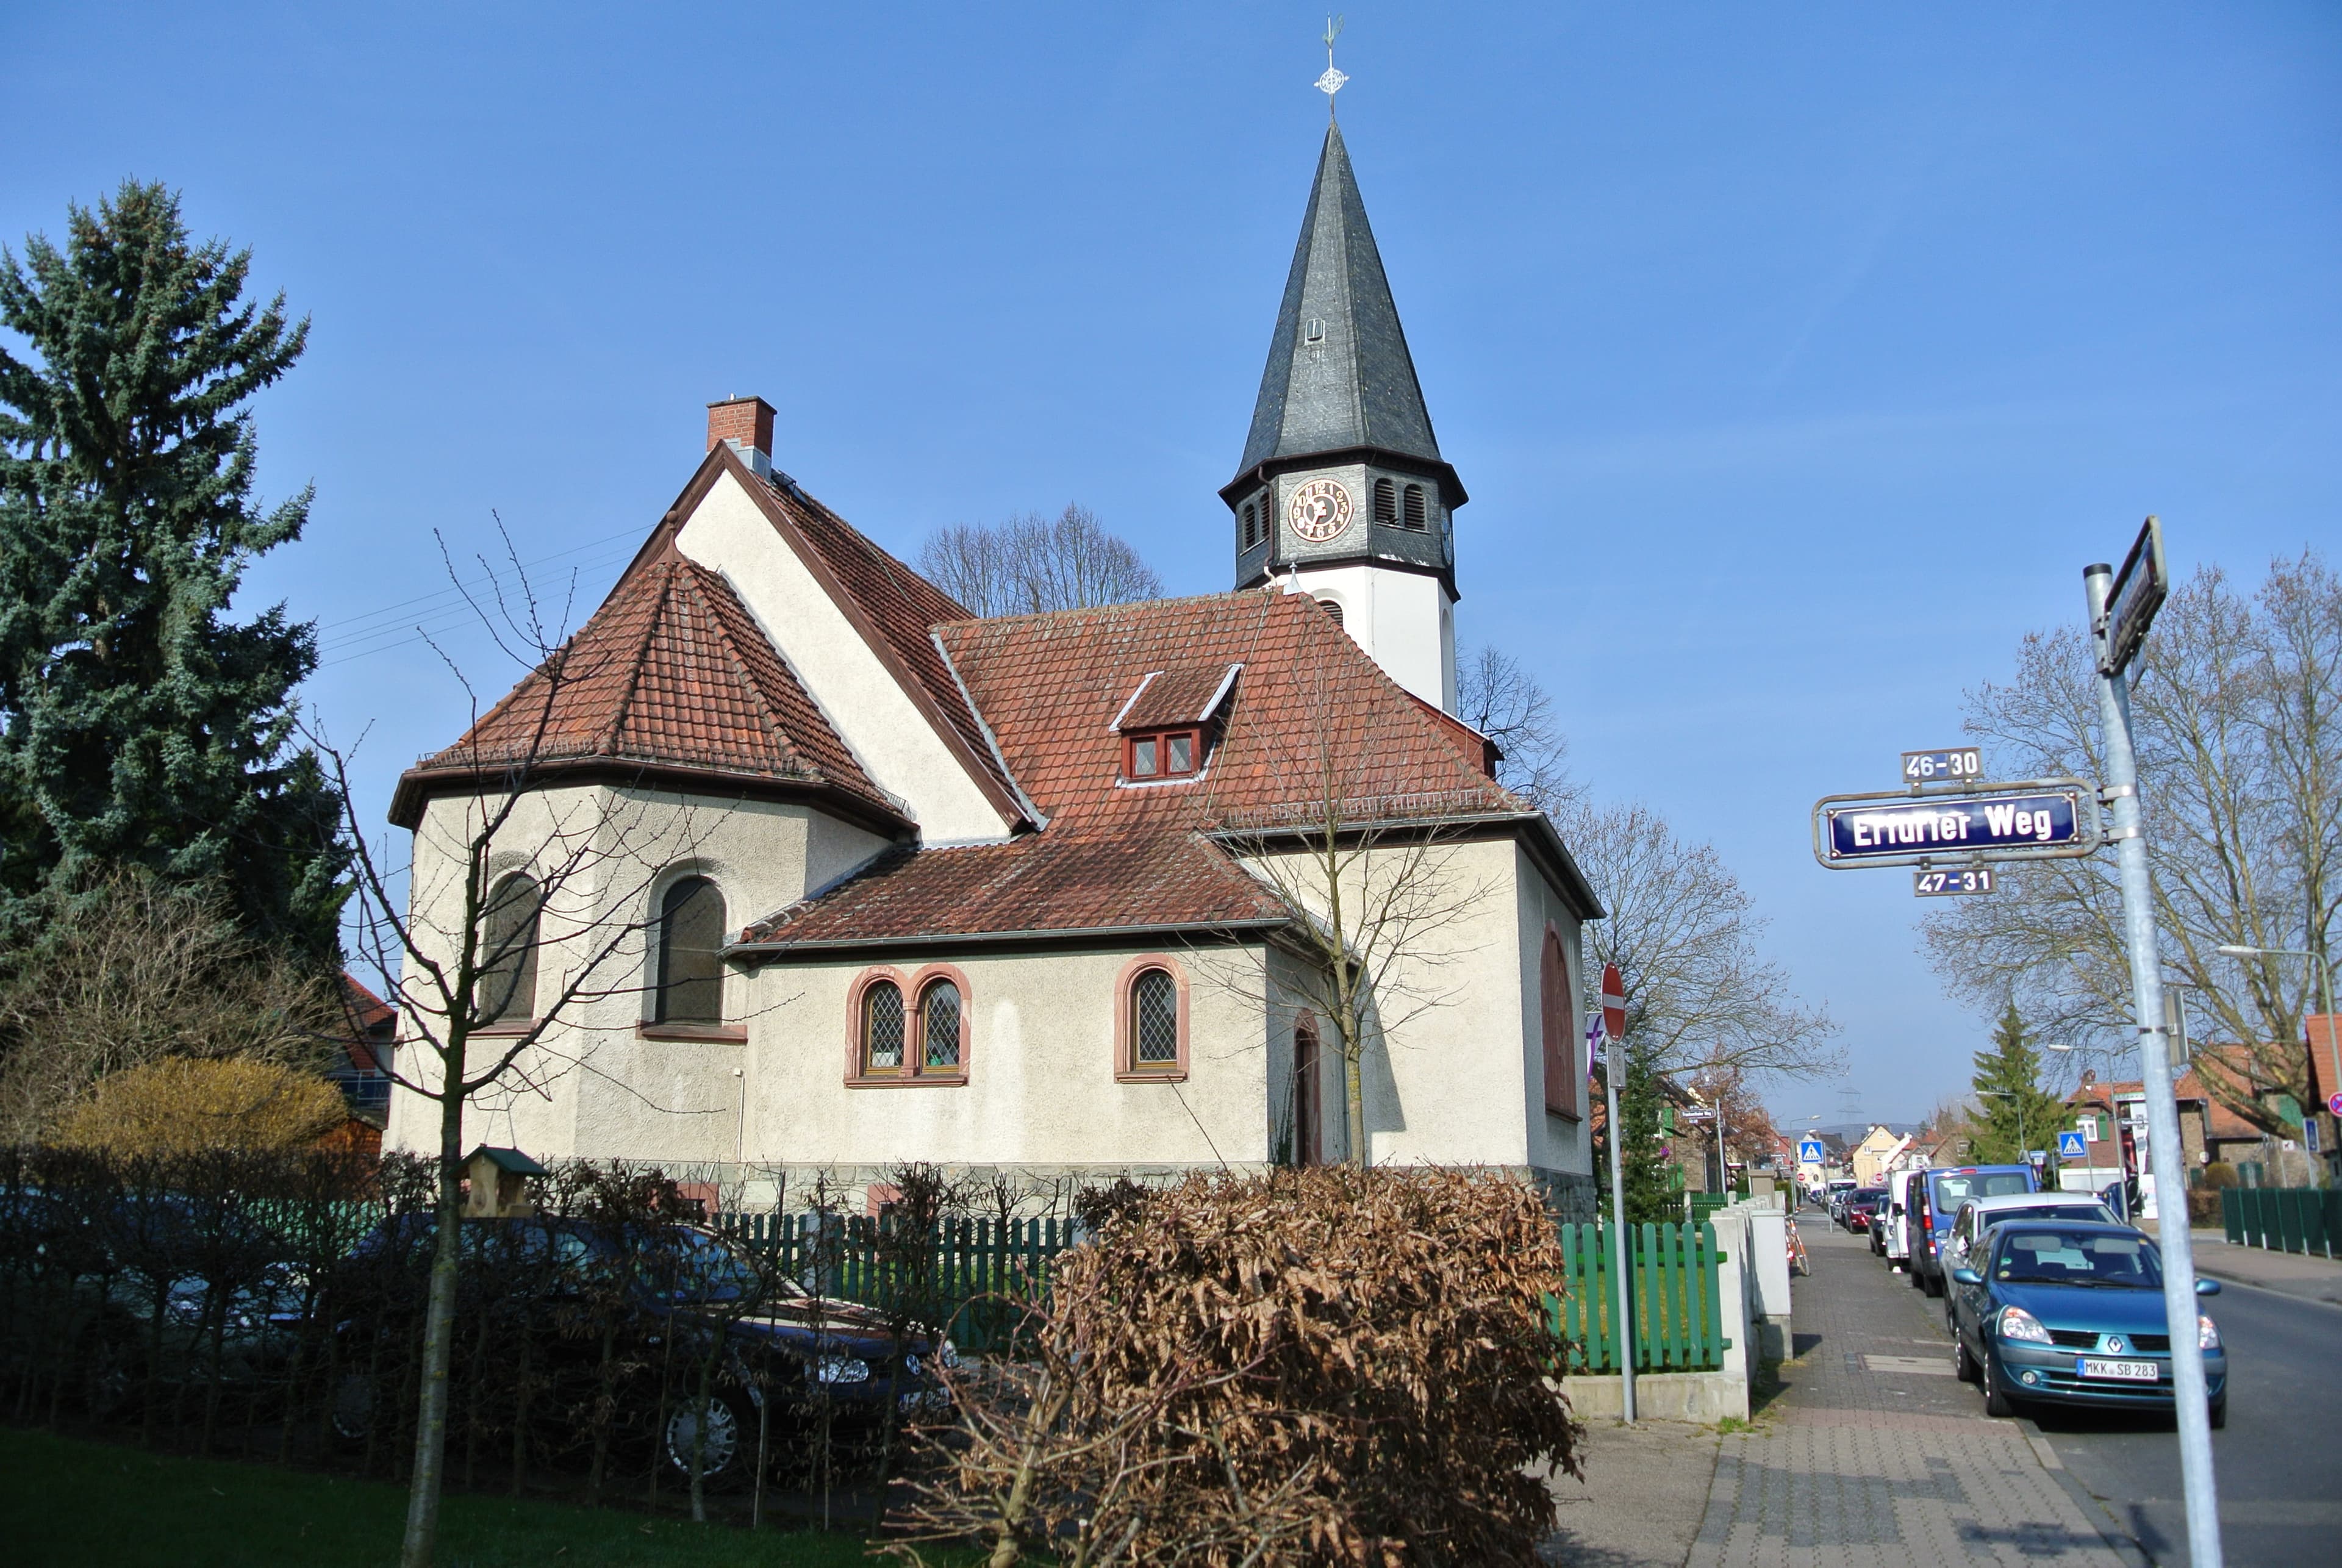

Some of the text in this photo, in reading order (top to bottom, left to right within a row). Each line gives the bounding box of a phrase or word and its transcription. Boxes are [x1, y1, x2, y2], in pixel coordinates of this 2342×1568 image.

[1315, 482, 1325, 494] 12
[1329, 484, 1334, 495] 1
[1296, 495, 1306, 507] 10
[1336, 491, 1344, 502] 2
[1293, 507, 1301, 518] 9
[1341, 502, 1348, 513] 3
[1297, 517, 1305, 529] 8
[1337, 513, 1344, 524] 4
[1317, 526, 1324, 538] 6
[1328, 523, 1336, 534] 5
[1907, 752, 1978, 777] 46-30
[1853, 804, 2052, 846] Erfurter Weg
[1918, 871, 1989, 892] 47-31
[2086, 1362, 2155, 1376] MKK SB 283
